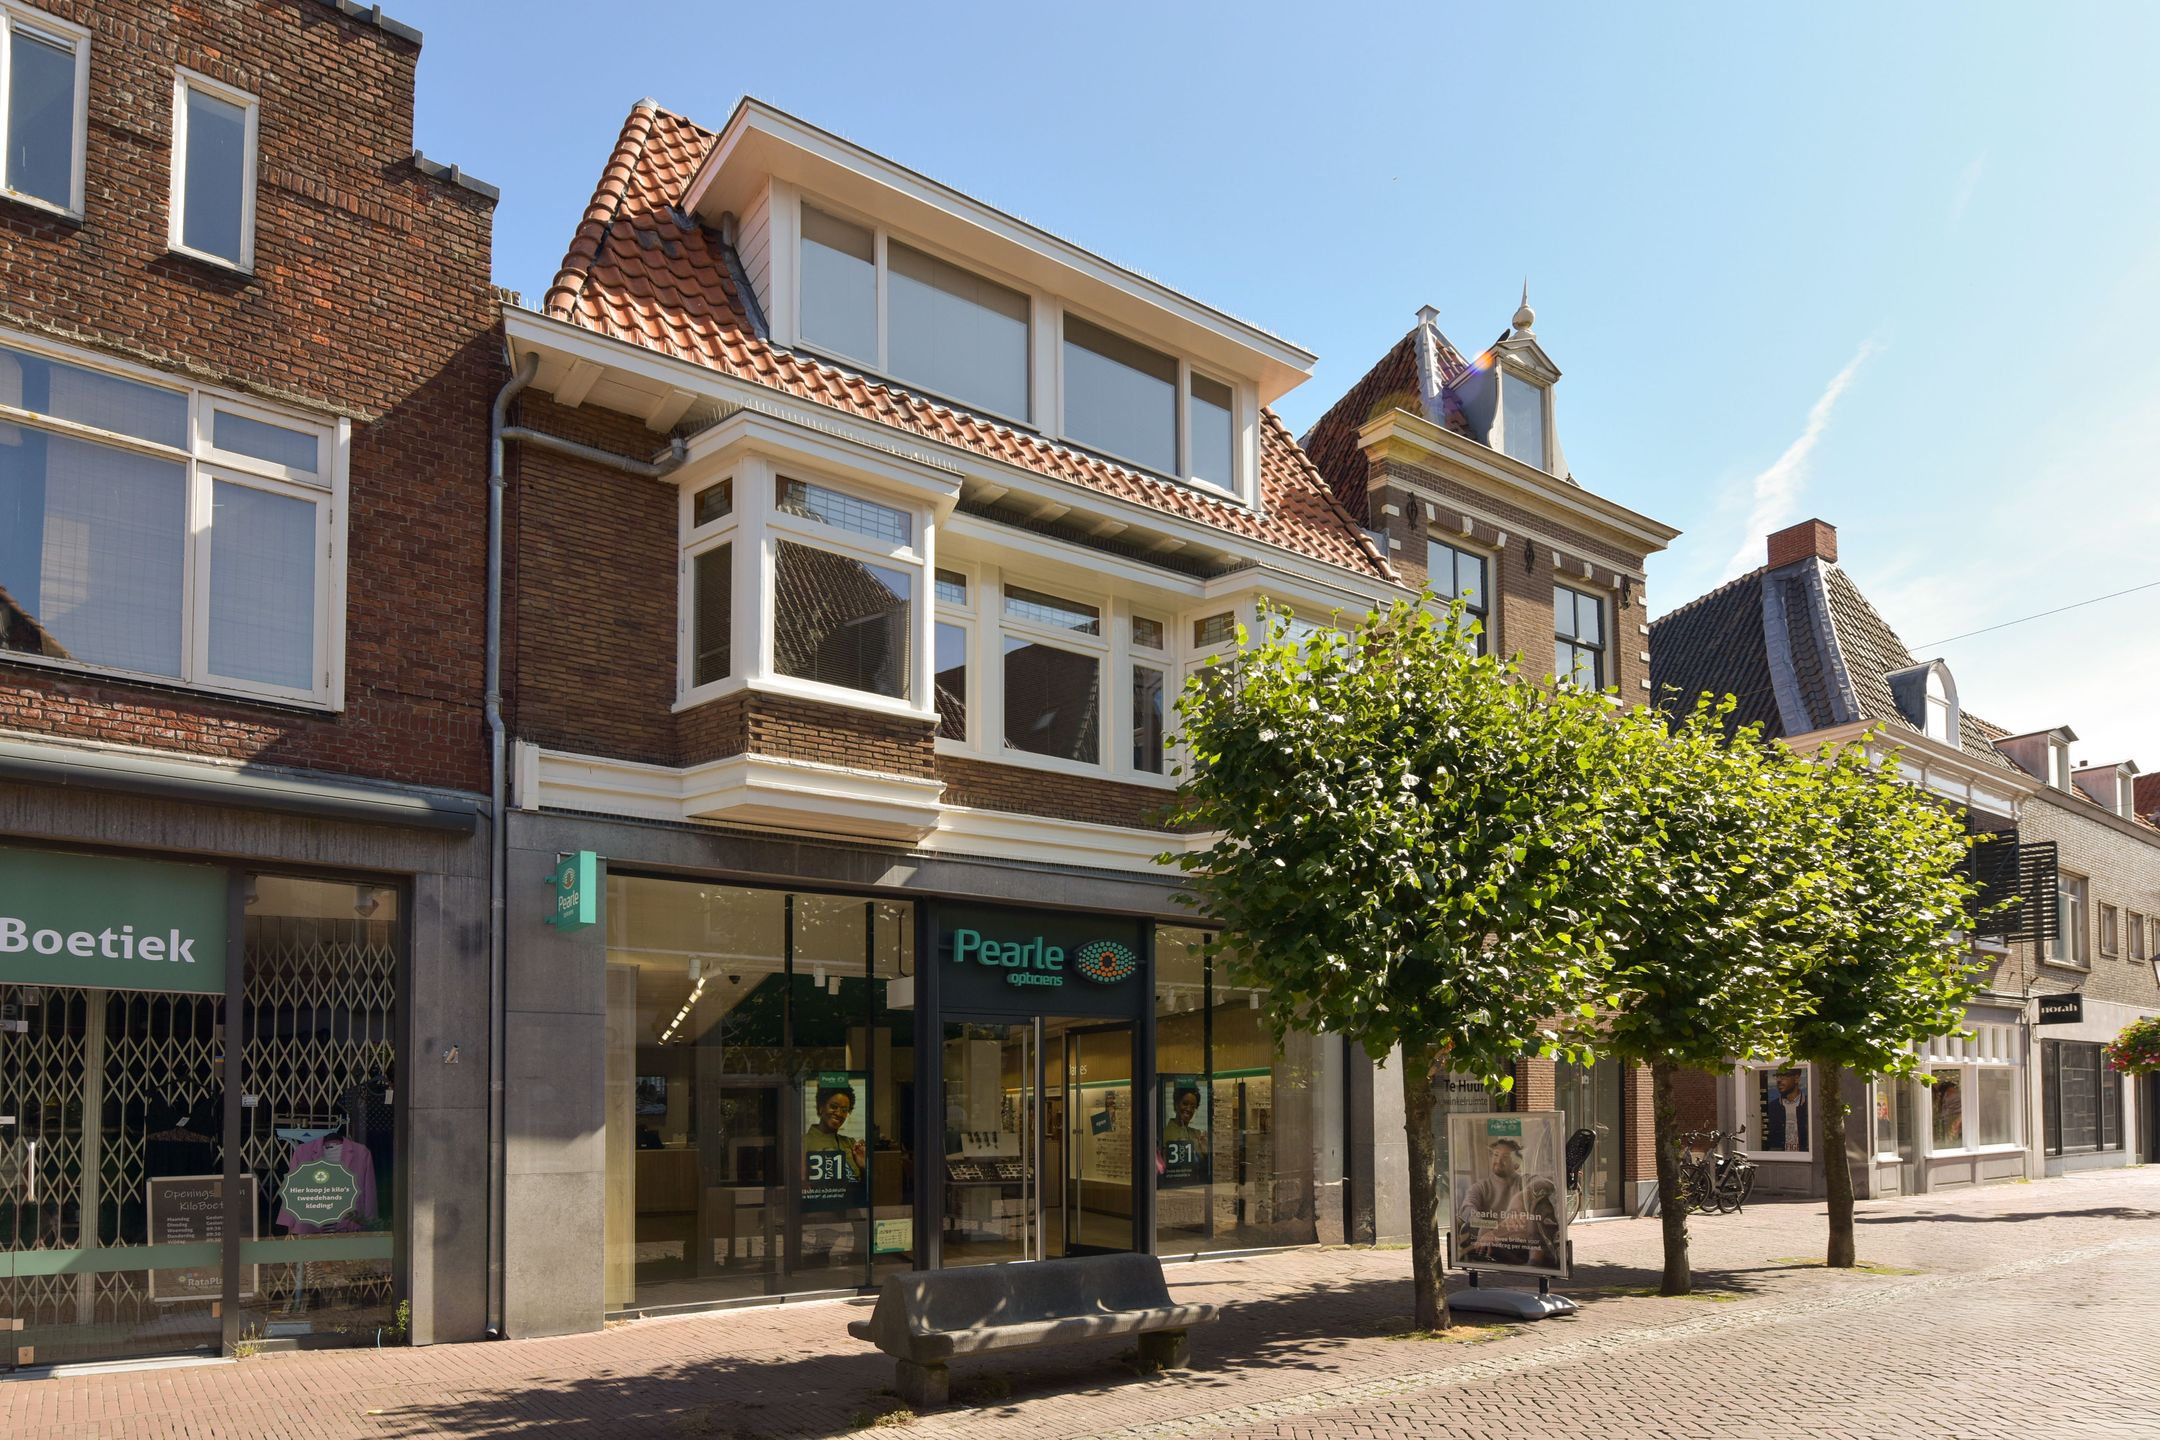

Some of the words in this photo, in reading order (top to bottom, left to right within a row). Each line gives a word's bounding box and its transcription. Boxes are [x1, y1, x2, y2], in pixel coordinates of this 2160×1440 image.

[558, 890, 579, 912] Pearle
[0, 917, 195, 963] Boetiek
[953, 928, 1064, 971] Pearle
[1007, 972, 1063, 986] opticiens
[2041, 1003, 2078, 1014] norah
[1444, 1079, 1456, 1092] Te
[1458, 1079, 1484, 1092] Huur
[809, 1154, 823, 1180] 3
[833, 1154, 842, 1179] 1
[305, 1202, 333, 1210] kleding!
[1470, 1209, 1498, 1219] Pearle
[1519, 1211, 1542, 1221] Plan
